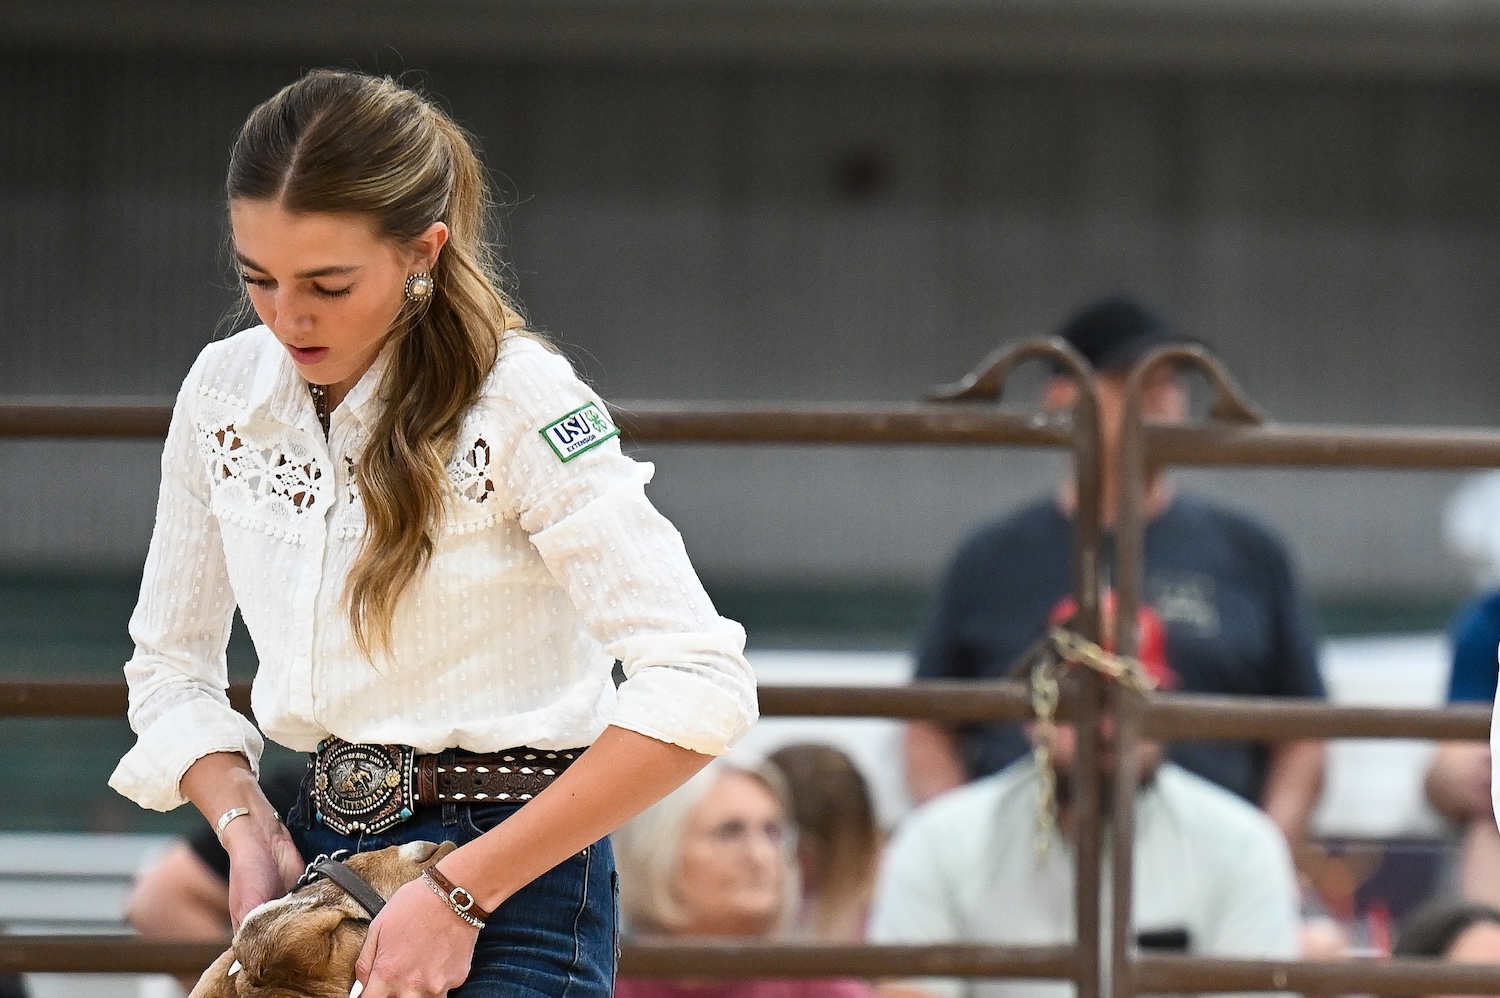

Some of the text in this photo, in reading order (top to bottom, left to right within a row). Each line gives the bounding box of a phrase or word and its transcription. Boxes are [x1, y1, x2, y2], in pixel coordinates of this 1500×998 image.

[553, 413, 591, 444] USU
[566, 434, 597, 453] EXTENSION
[369, 754, 384, 768] DAYS
[340, 779, 388, 810] ATTENDANT
